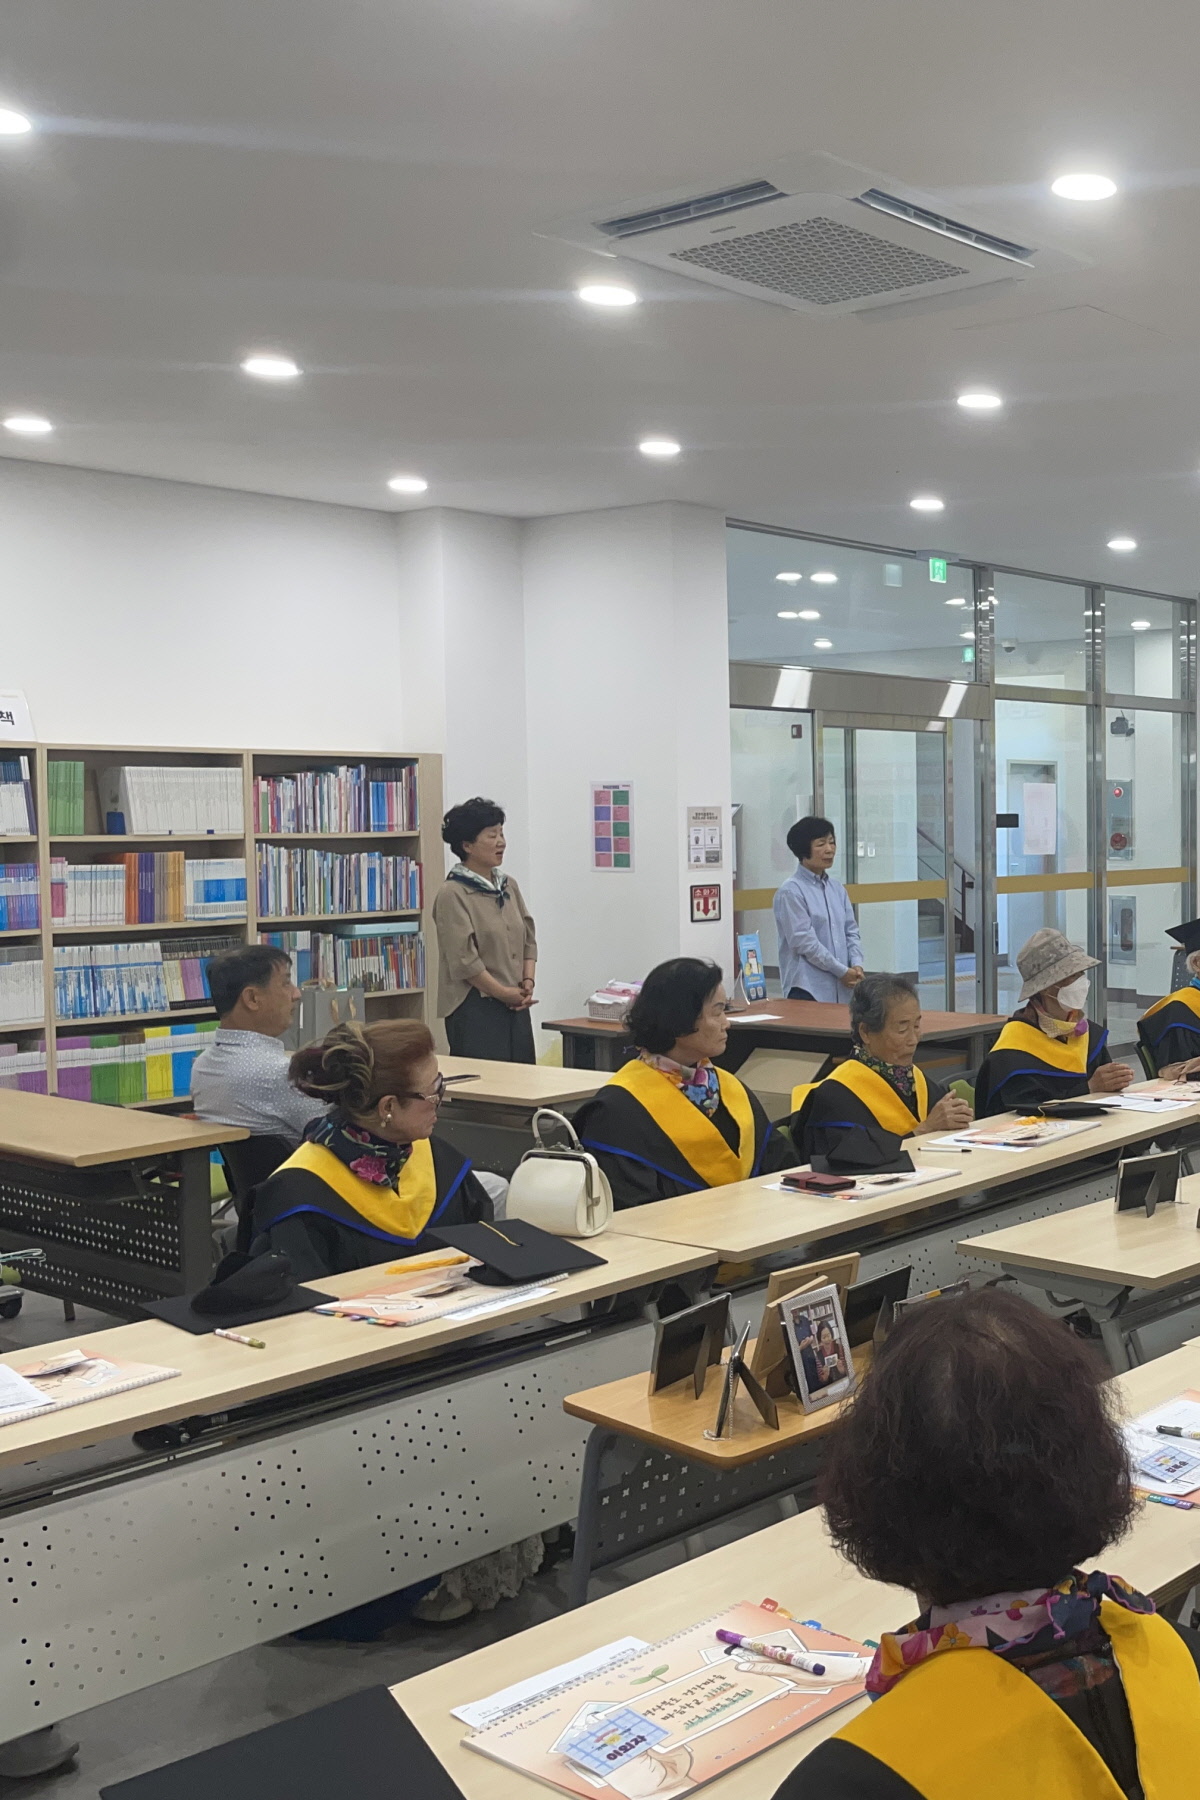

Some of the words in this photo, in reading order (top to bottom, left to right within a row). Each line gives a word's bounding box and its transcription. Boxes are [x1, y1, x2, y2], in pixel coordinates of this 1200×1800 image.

[694, 888, 718, 896] 소화기
[682, 1674, 727, 1696] 건강마을
[661, 1698, 703, 1721] 마음학교
